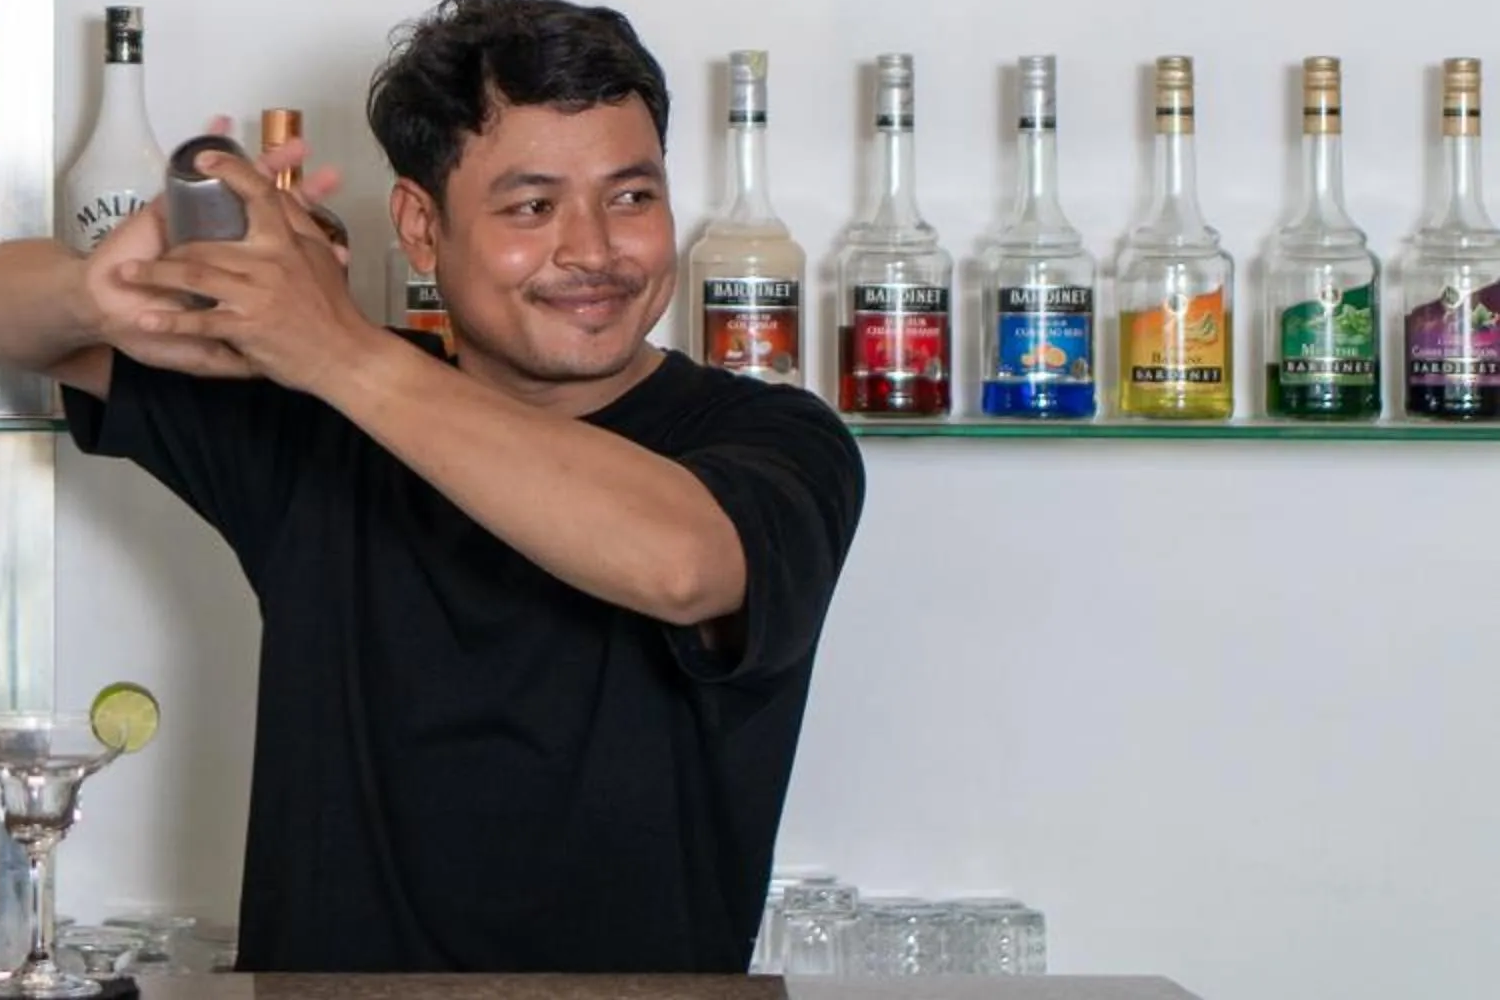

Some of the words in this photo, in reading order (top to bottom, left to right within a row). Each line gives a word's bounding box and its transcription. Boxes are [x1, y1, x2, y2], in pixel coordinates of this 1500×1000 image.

[76, 194, 145, 233] MALI
[1287, 361, 1372, 373] BARINET
[1413, 362, 1497, 374] BARDIET
